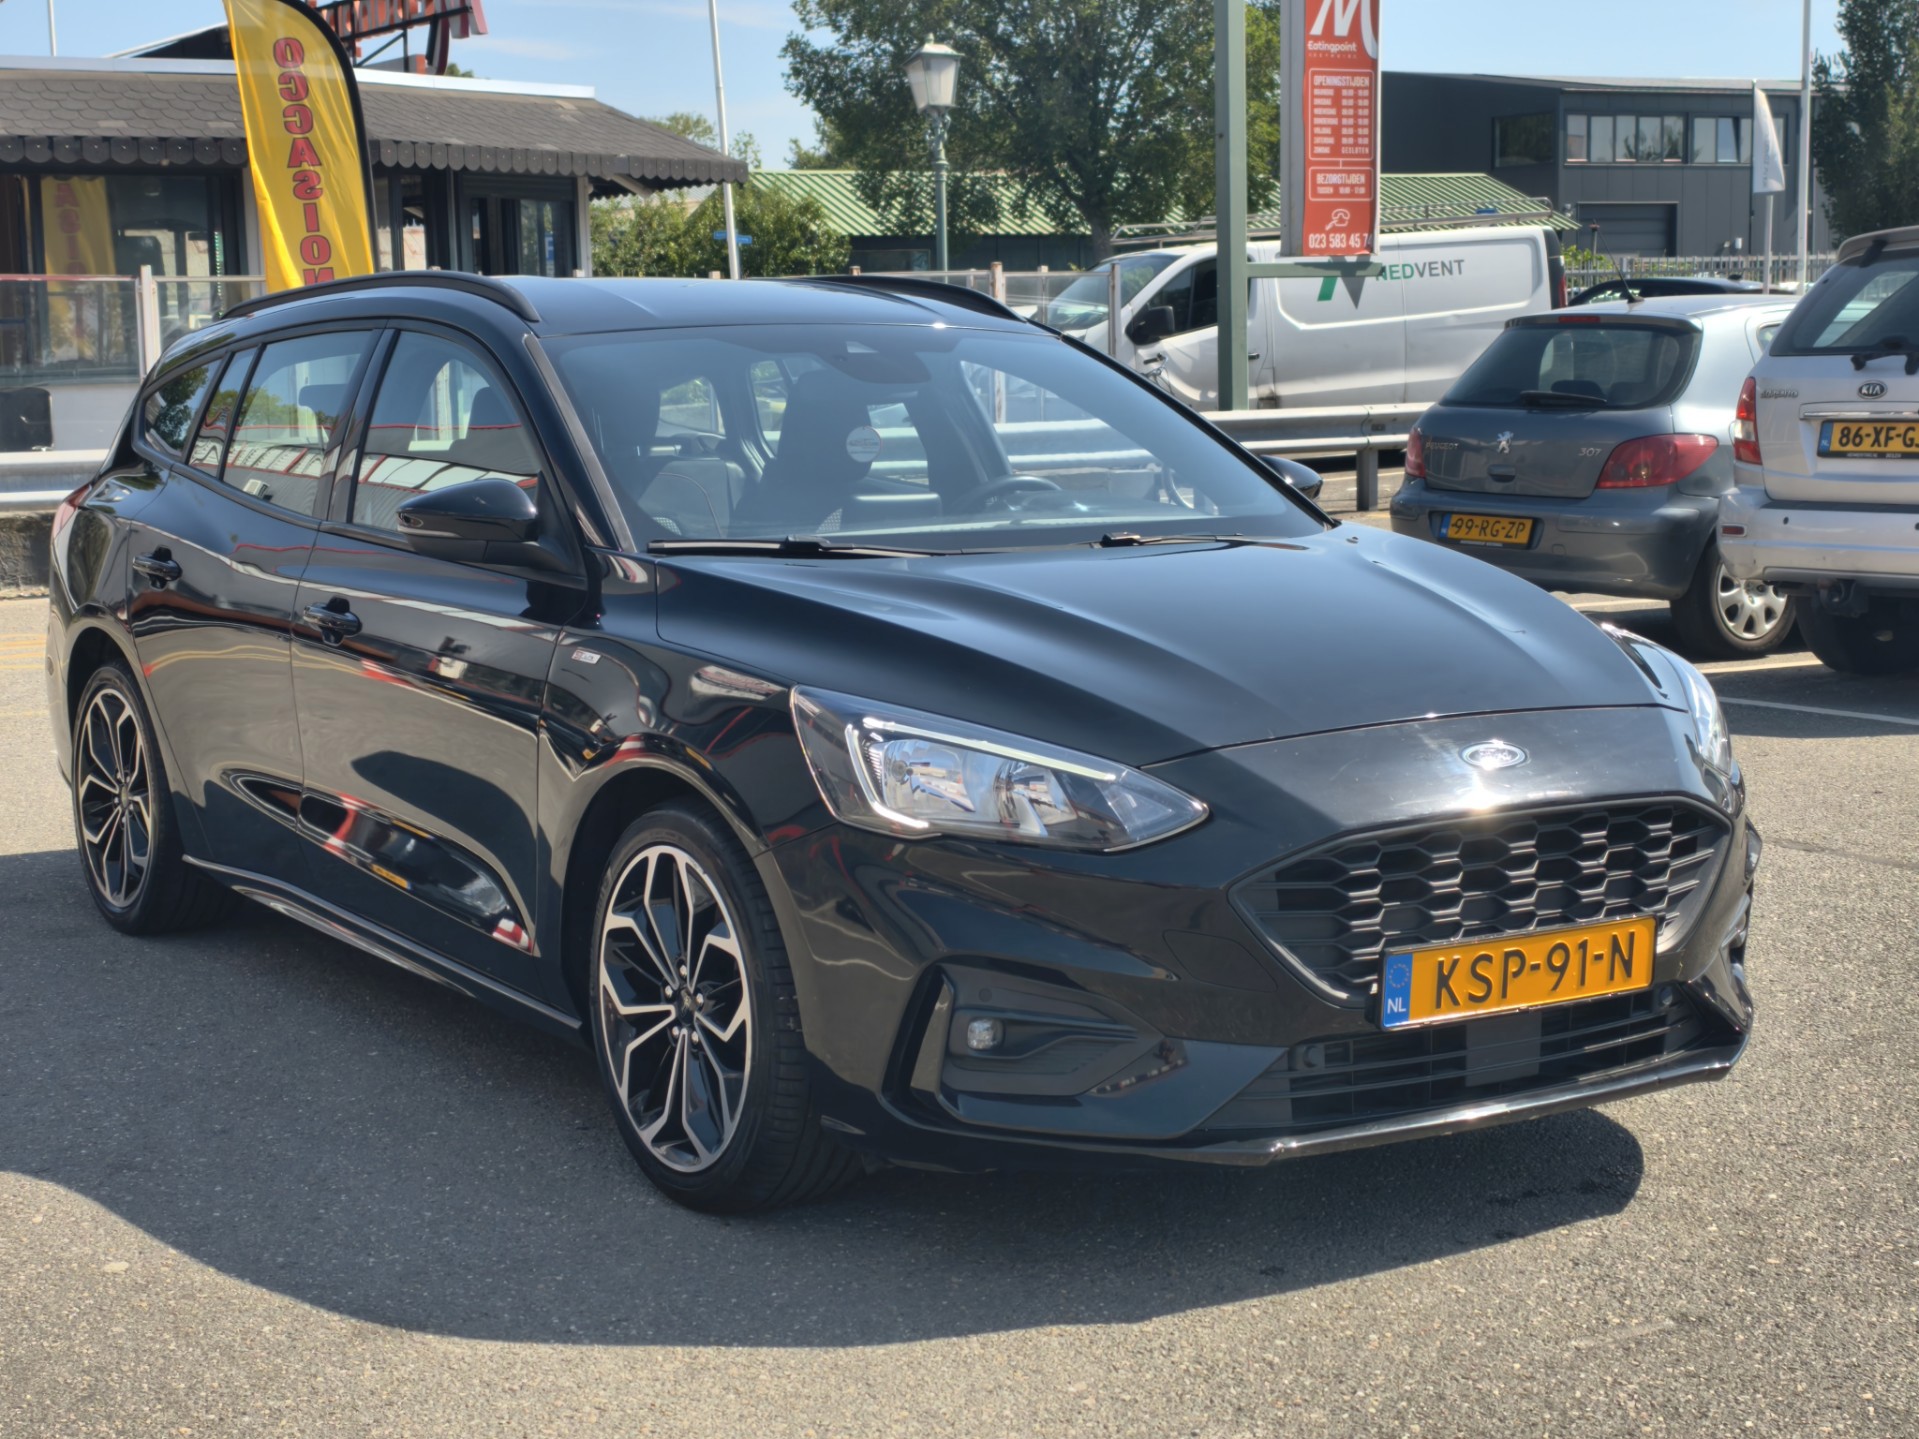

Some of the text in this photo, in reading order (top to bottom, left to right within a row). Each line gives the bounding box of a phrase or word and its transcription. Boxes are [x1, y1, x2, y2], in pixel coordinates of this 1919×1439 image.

[1307, 40, 1357, 53] Eatingpoint
[1308, 233, 1327, 249] 023
[1329, 233, 1346, 249] 583
[1348, 233, 1361, 248] 45
[1861, 382, 1882, 395] KIA
[1838, 425, 1919, 449] 86-XF-G
[1425, 440, 1459, 451] PEUGEOT
[1578, 447, 1602, 457] 307
[1454, 517, 1526, 539] 99-RG-ZP
[1434, 931, 1636, 1010] KSP-91-N
[1387, 998, 1407, 1014] NL
